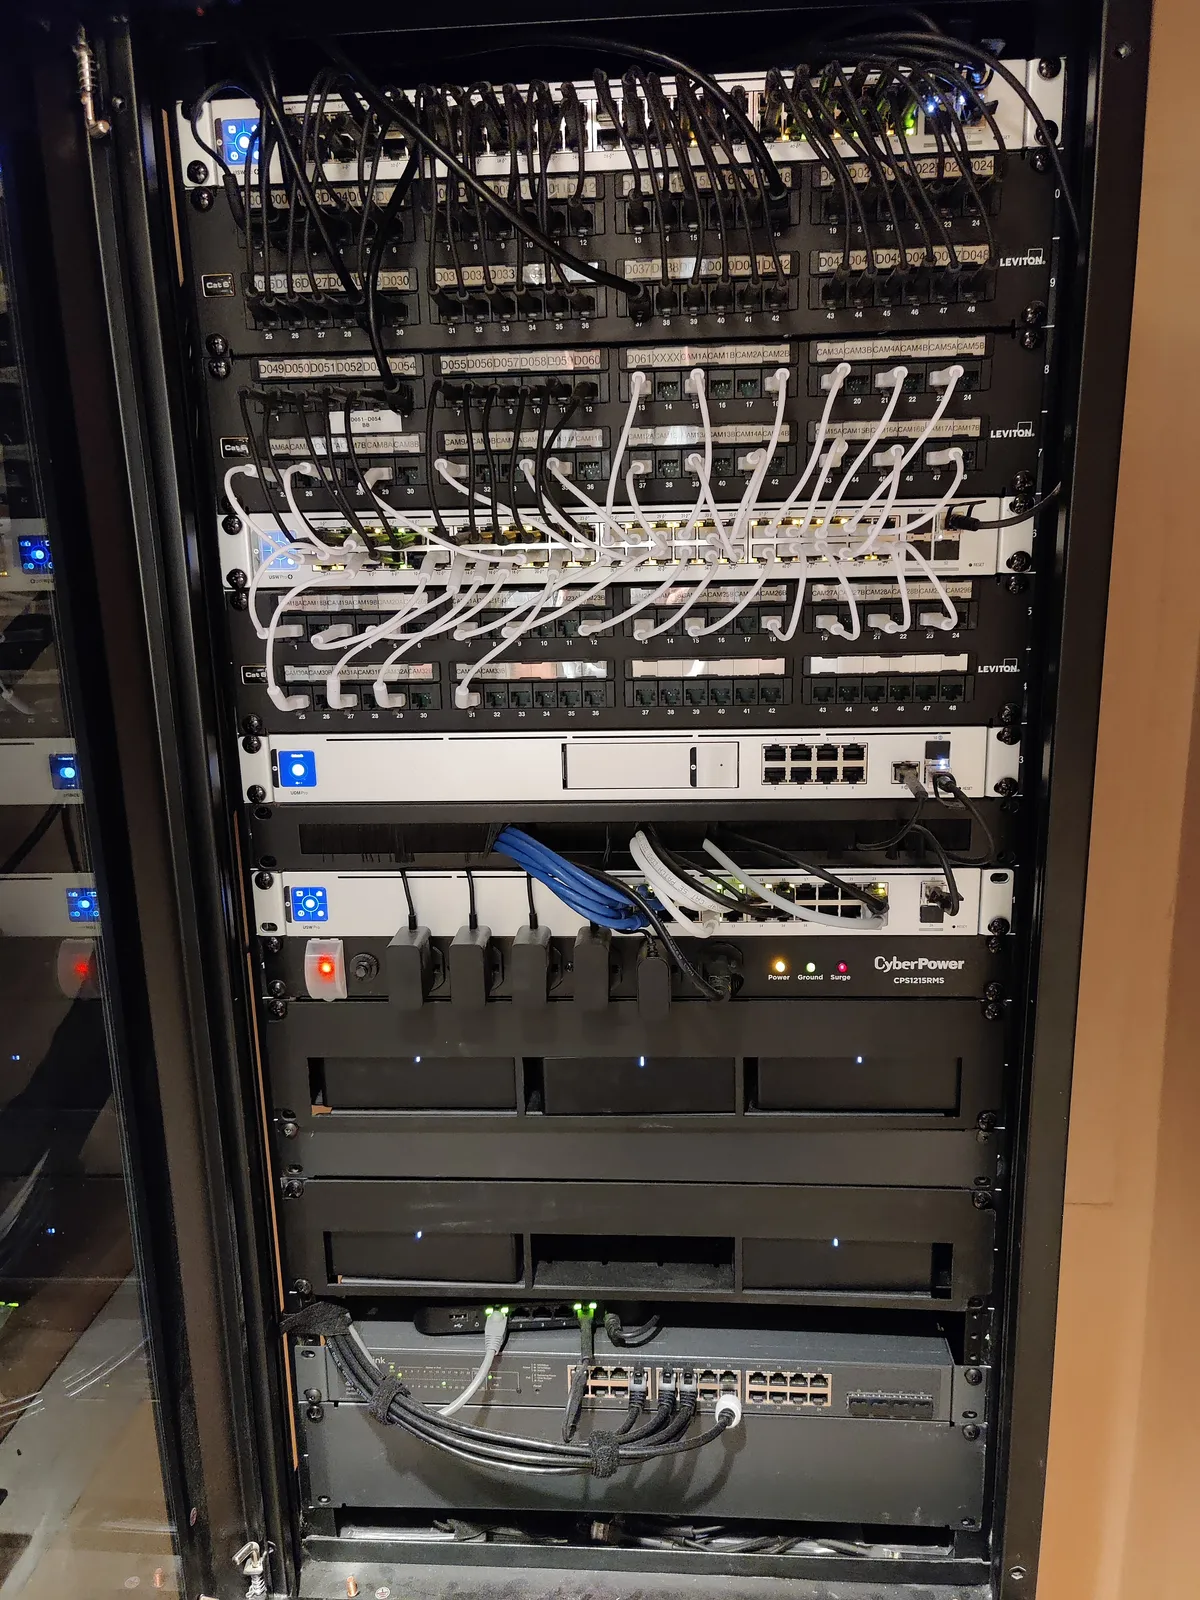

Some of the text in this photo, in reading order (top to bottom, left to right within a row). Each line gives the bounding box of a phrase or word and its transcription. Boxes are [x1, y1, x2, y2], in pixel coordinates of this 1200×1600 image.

[1000, 255, 1043, 267] LEVITON
[206, 281, 221, 289] Cat
[383, 275, 410, 286] D030
[844, 347, 872, 355] CAM3B
[872, 345, 900, 354] CAM4A
[958, 342, 985, 350] CAM5B
[707, 351, 735, 360] CAM1B
[735, 351, 762, 359] CAM2A
[259, 364, 284, 374] D049
[284, 363, 310, 374] D050
[310, 363, 335, 373] D051
[337, 362, 363, 372] D052
[441, 359, 467, 370] D055
[467, 358, 493, 369] D056
[493, 357, 519, 368] D057
[521, 356, 547, 367] D058
[574, 355, 600, 365] D060
[990, 429, 1032, 438] LEVITON
[978, 665, 1018, 673] LEVITON
[874, 955, 965, 973] CyberPower
